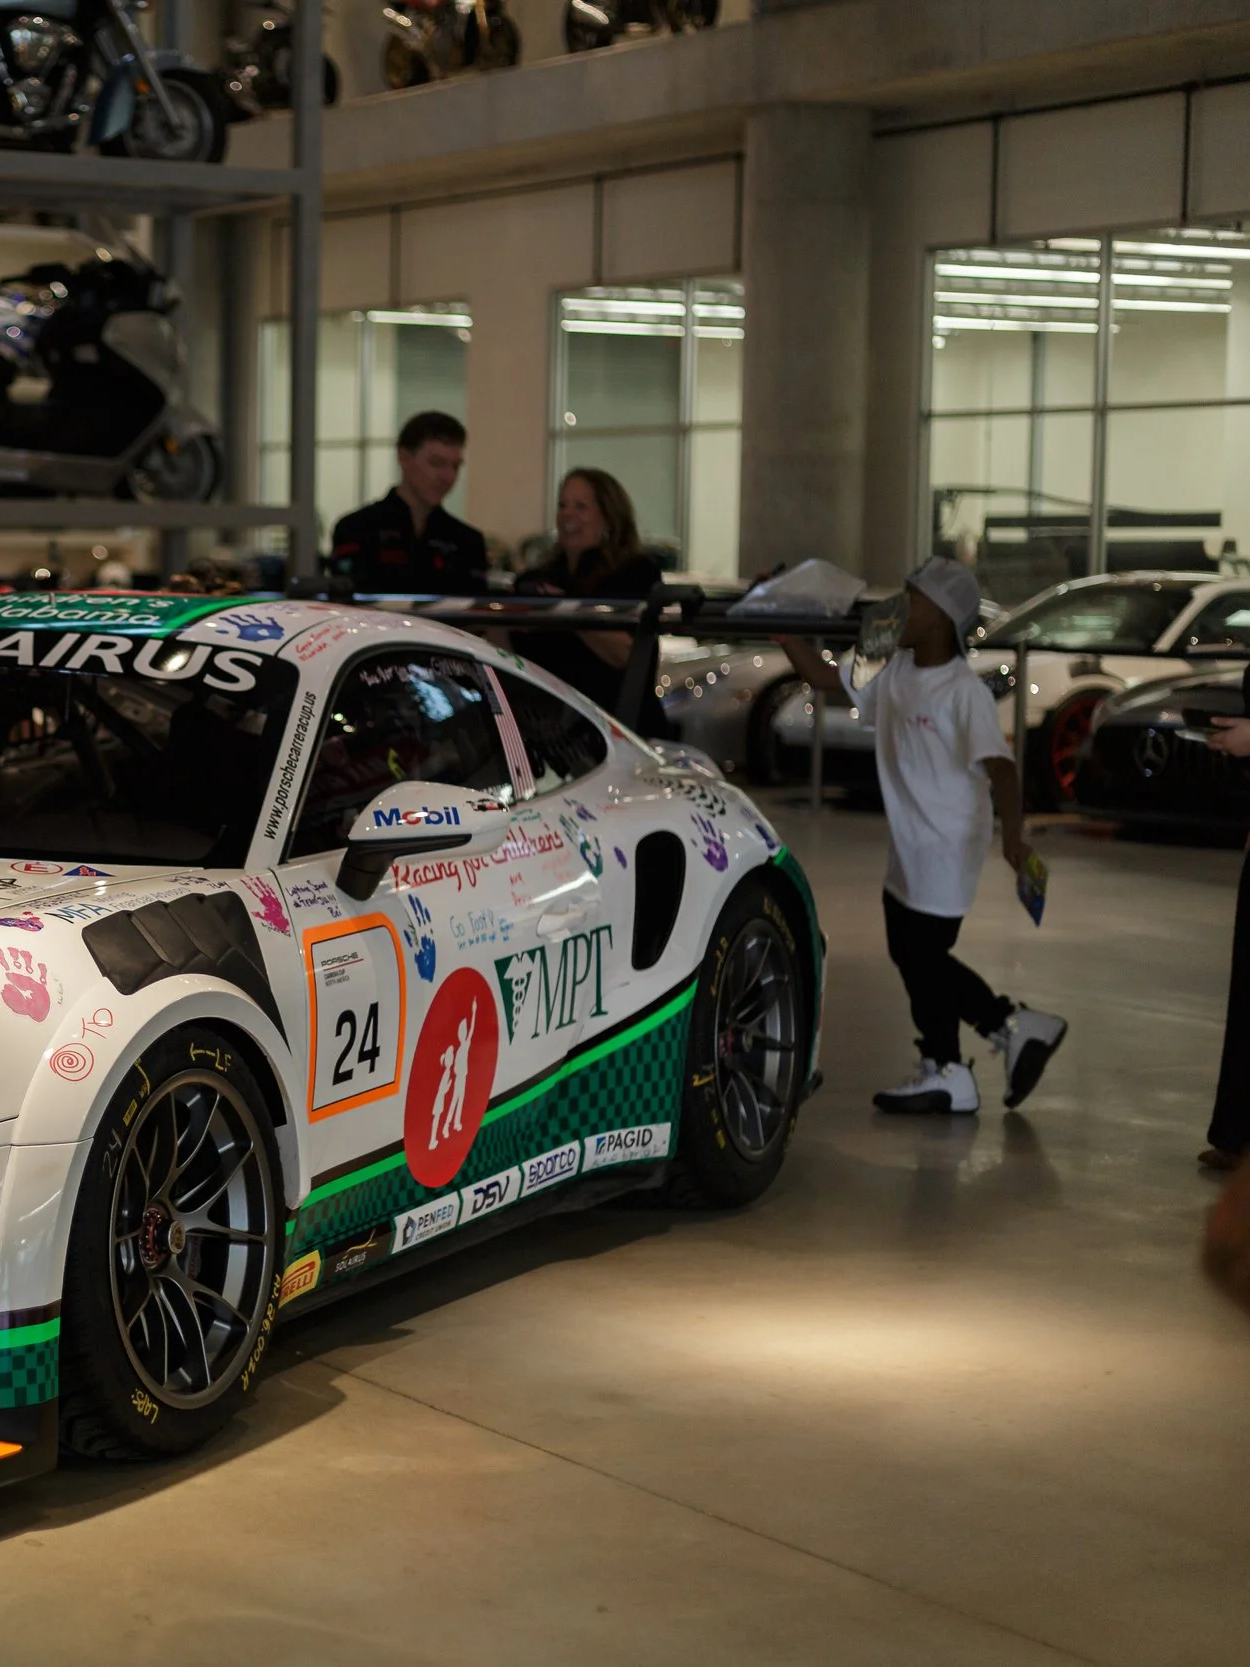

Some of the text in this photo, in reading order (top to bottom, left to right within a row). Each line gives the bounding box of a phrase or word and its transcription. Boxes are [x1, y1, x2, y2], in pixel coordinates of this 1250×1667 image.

[264, 691, 317, 840] www.porschecarreracup.us
[373, 806, 461, 828] Mobil
[392, 859, 461, 892] Racing
[320, 951, 359, 967] PORSCHE
[532, 924, 613, 1039] MPT
[332, 1001, 381, 1087] 24
[606, 1127, 653, 1152] PAGID
[528, 1147, 577, 1187] sparco
[471, 1176, 509, 1215] DSV
[417, 1204, 454, 1230] PENFED
[335, 1251, 367, 1273] SOLAIRUS
